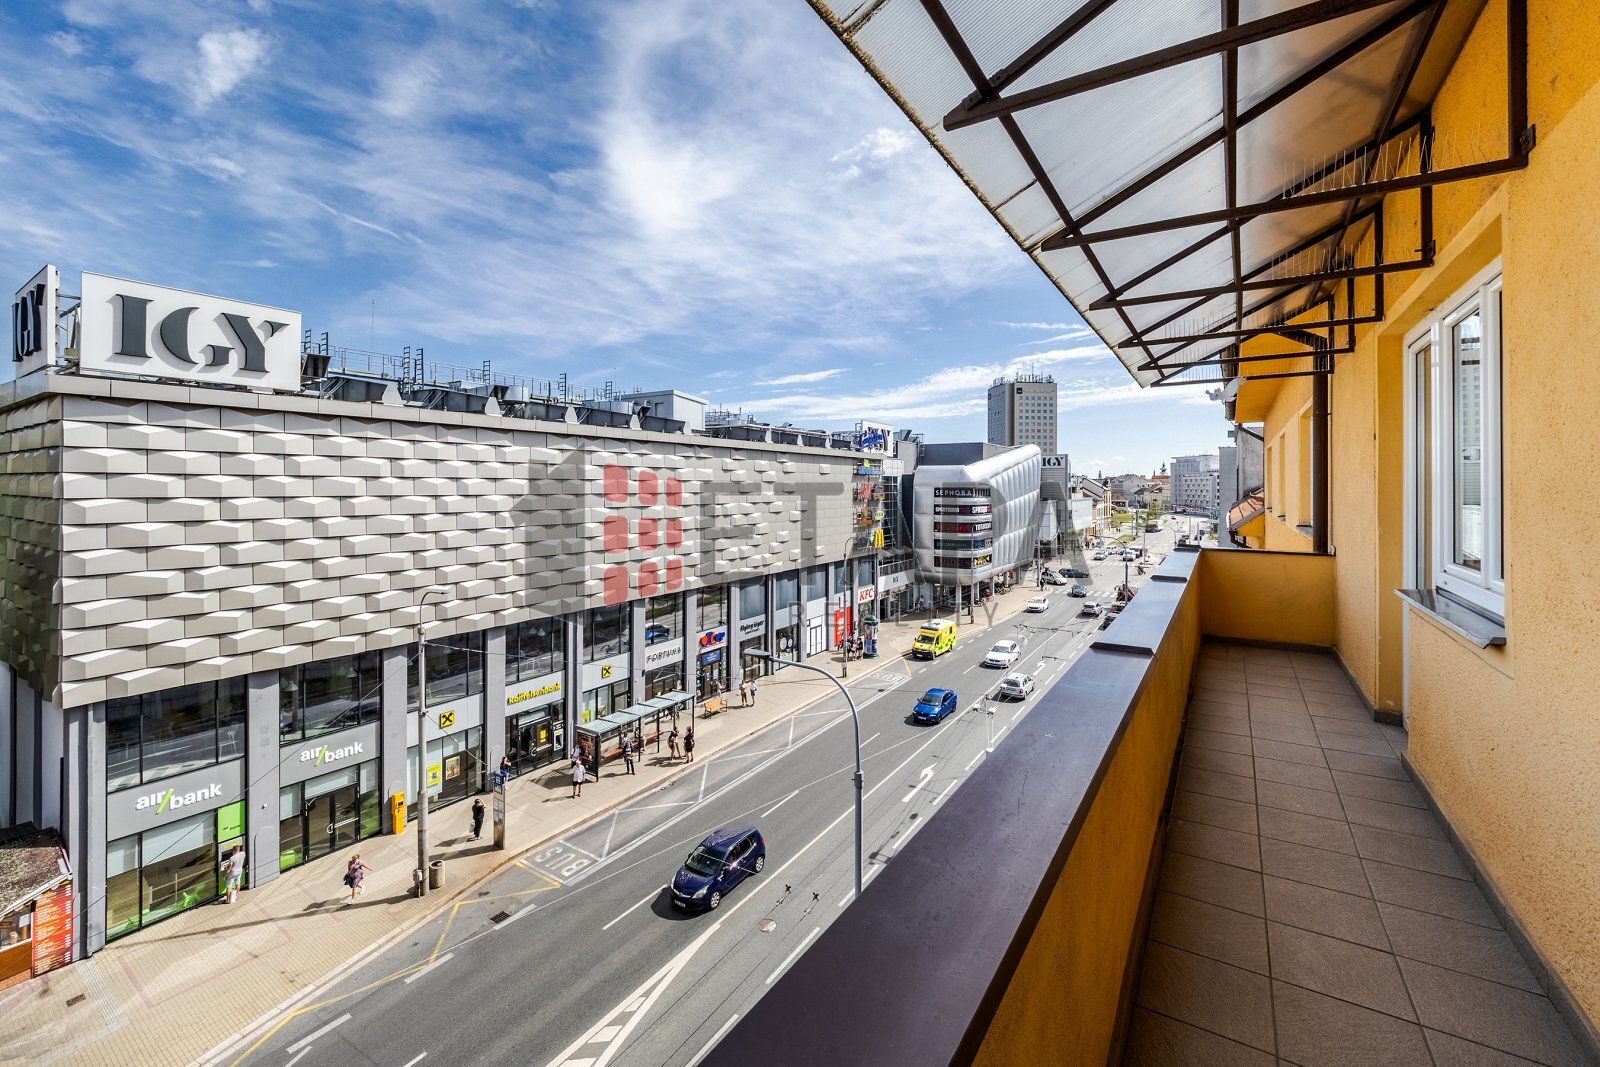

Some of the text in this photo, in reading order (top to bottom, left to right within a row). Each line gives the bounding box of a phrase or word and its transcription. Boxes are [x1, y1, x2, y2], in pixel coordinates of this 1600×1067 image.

[115, 294, 289, 373] IGY
[1042, 457, 1064, 467] IGY
[859, 587, 874, 602] KFC
[646, 647, 682, 664] FORTUNA
[507, 682, 562, 706] Raiffeisenbank
[534, 846, 592, 877] BUS
